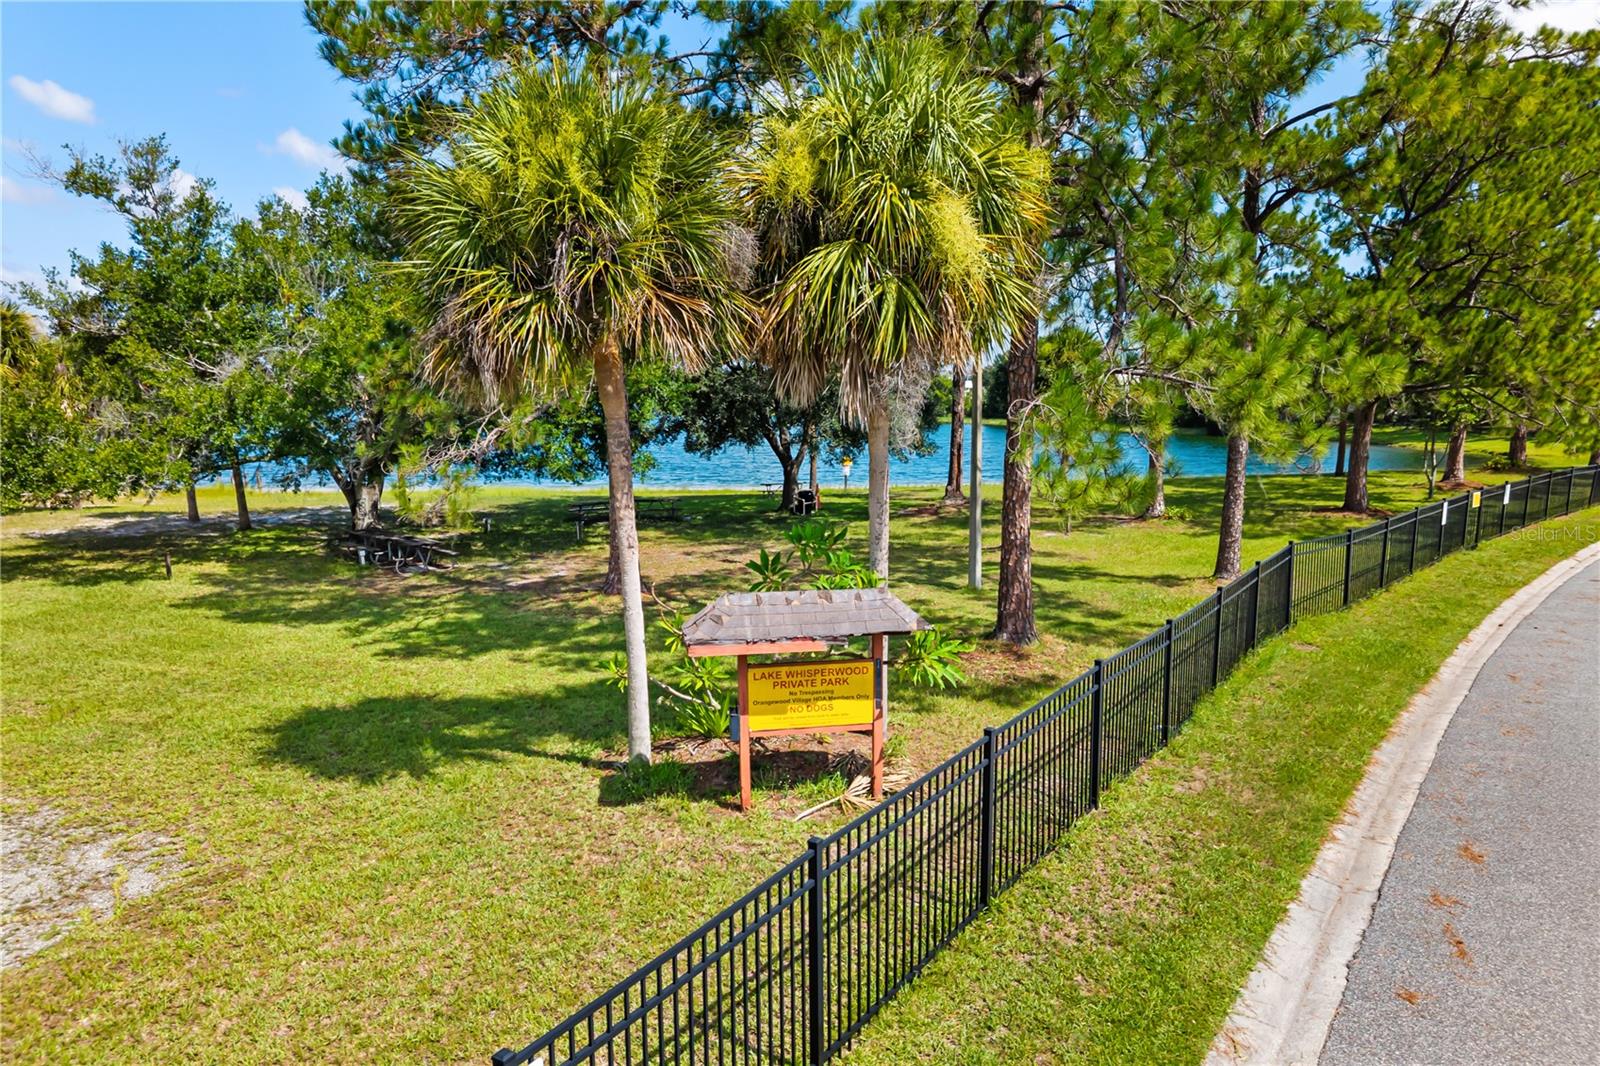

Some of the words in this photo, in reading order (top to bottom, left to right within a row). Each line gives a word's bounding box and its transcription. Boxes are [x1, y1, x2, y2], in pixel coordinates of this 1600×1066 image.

[753, 671, 782, 680] LAKE
[785, 666, 869, 678] WHISPERWOOD
[772, 679, 816, 689] PRIVATE
[820, 677, 849, 686] PARK
[789, 705, 804, 713] NO
[806, 704, 834, 712] DOGS
